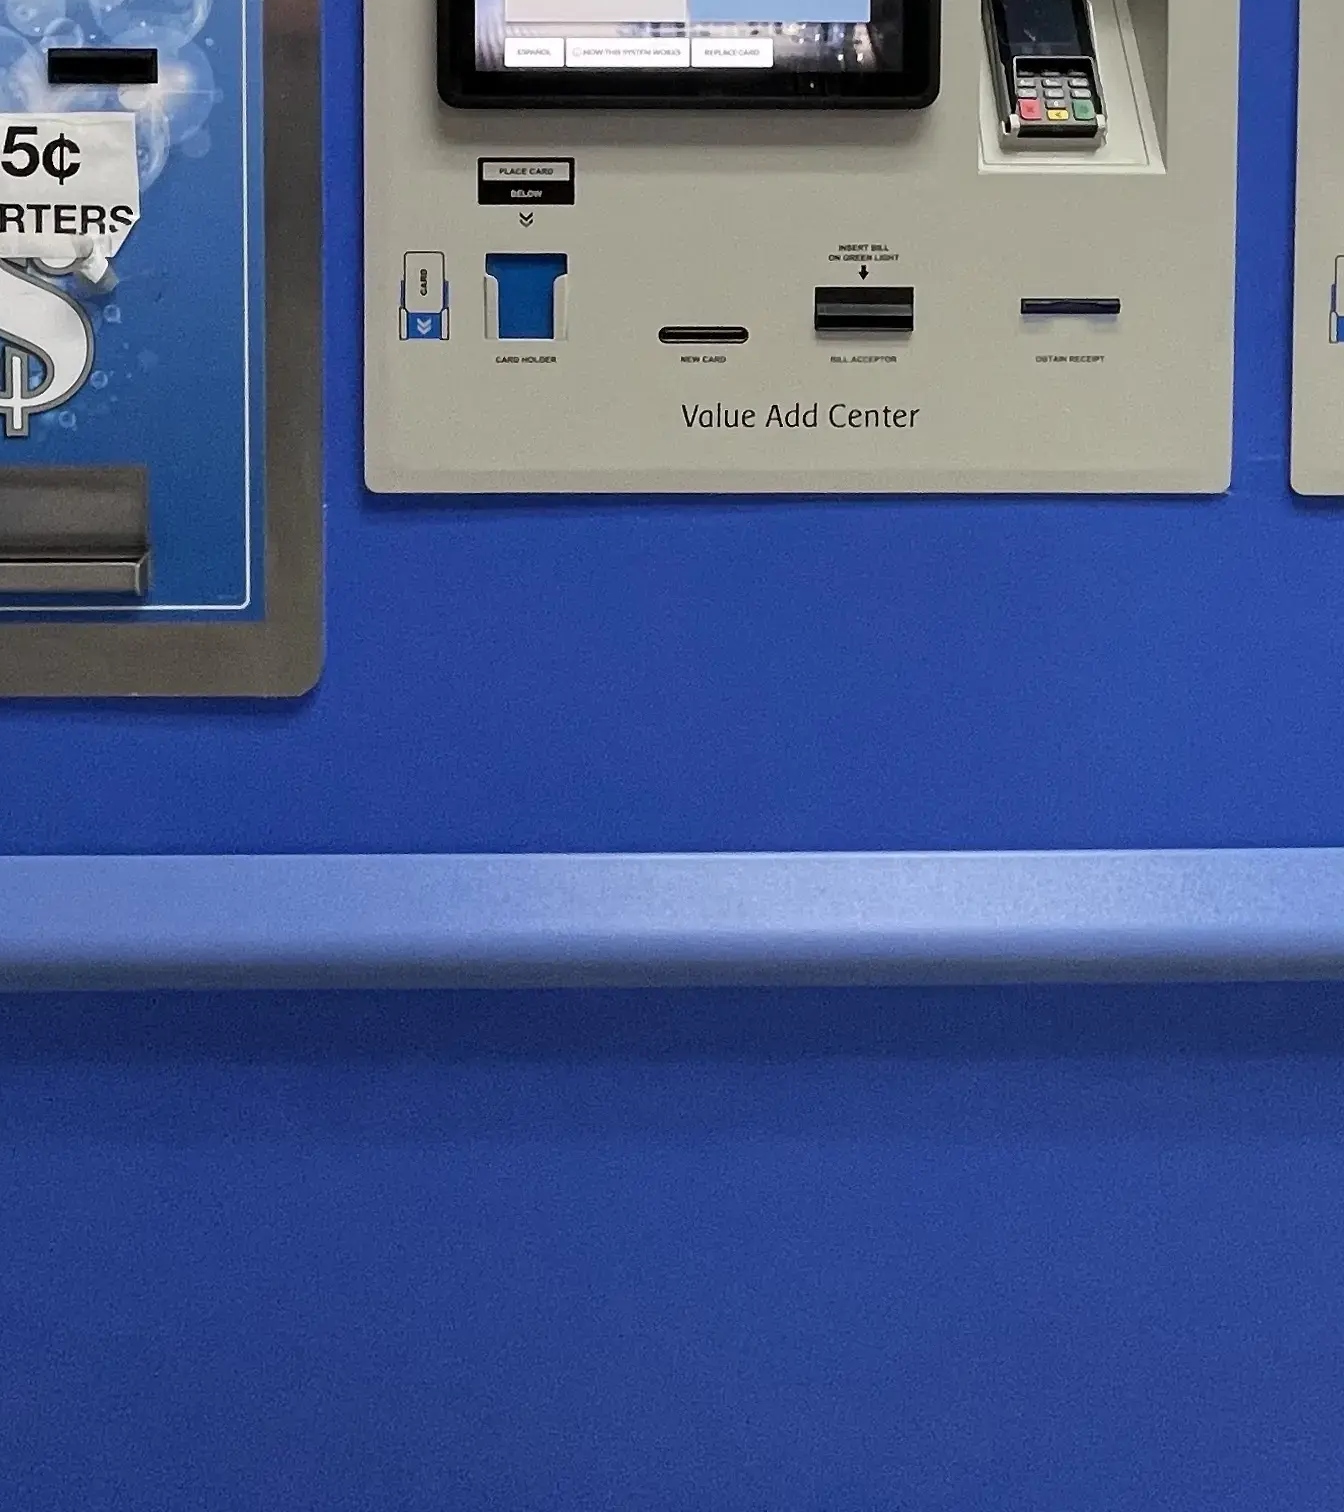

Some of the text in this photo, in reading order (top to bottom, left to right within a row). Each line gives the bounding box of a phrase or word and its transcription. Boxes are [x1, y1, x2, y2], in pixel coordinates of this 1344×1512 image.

[497, 167, 554, 176] PLACE CARD
[419, 268, 429, 297] CARD
[494, 355, 520, 364] CARD
[679, 355, 726, 364] NEW CARD
[680, 402, 919, 429] Value Add Center
